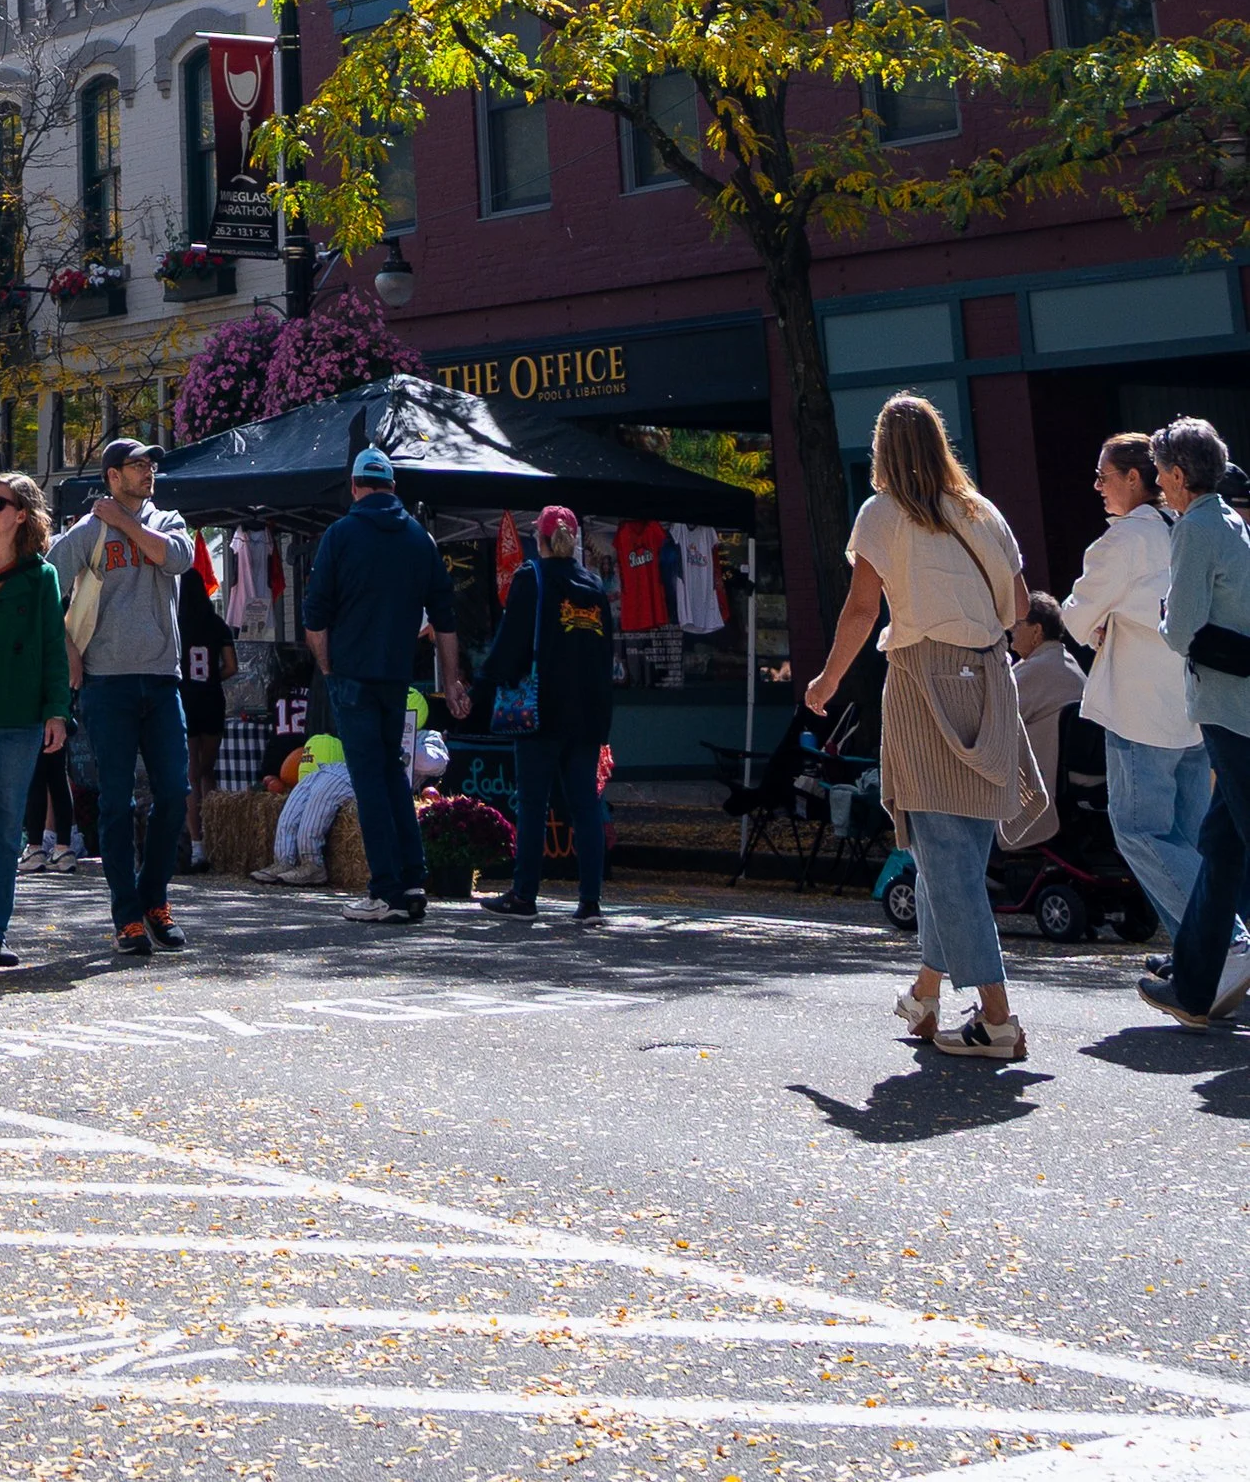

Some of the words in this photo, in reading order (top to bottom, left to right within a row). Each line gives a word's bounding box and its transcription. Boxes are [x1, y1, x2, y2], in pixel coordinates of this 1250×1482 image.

[437, 361, 500, 395] THE
[509, 346, 626, 399] OFFICE
[537, 390, 562, 402] POOL
[565, 388, 571, 399] &
[575, 383, 626, 398] LIBATIONS
[105, 537, 155, 572] RI
[189, 646, 209, 682] 8
[276, 698, 308, 735] 12
